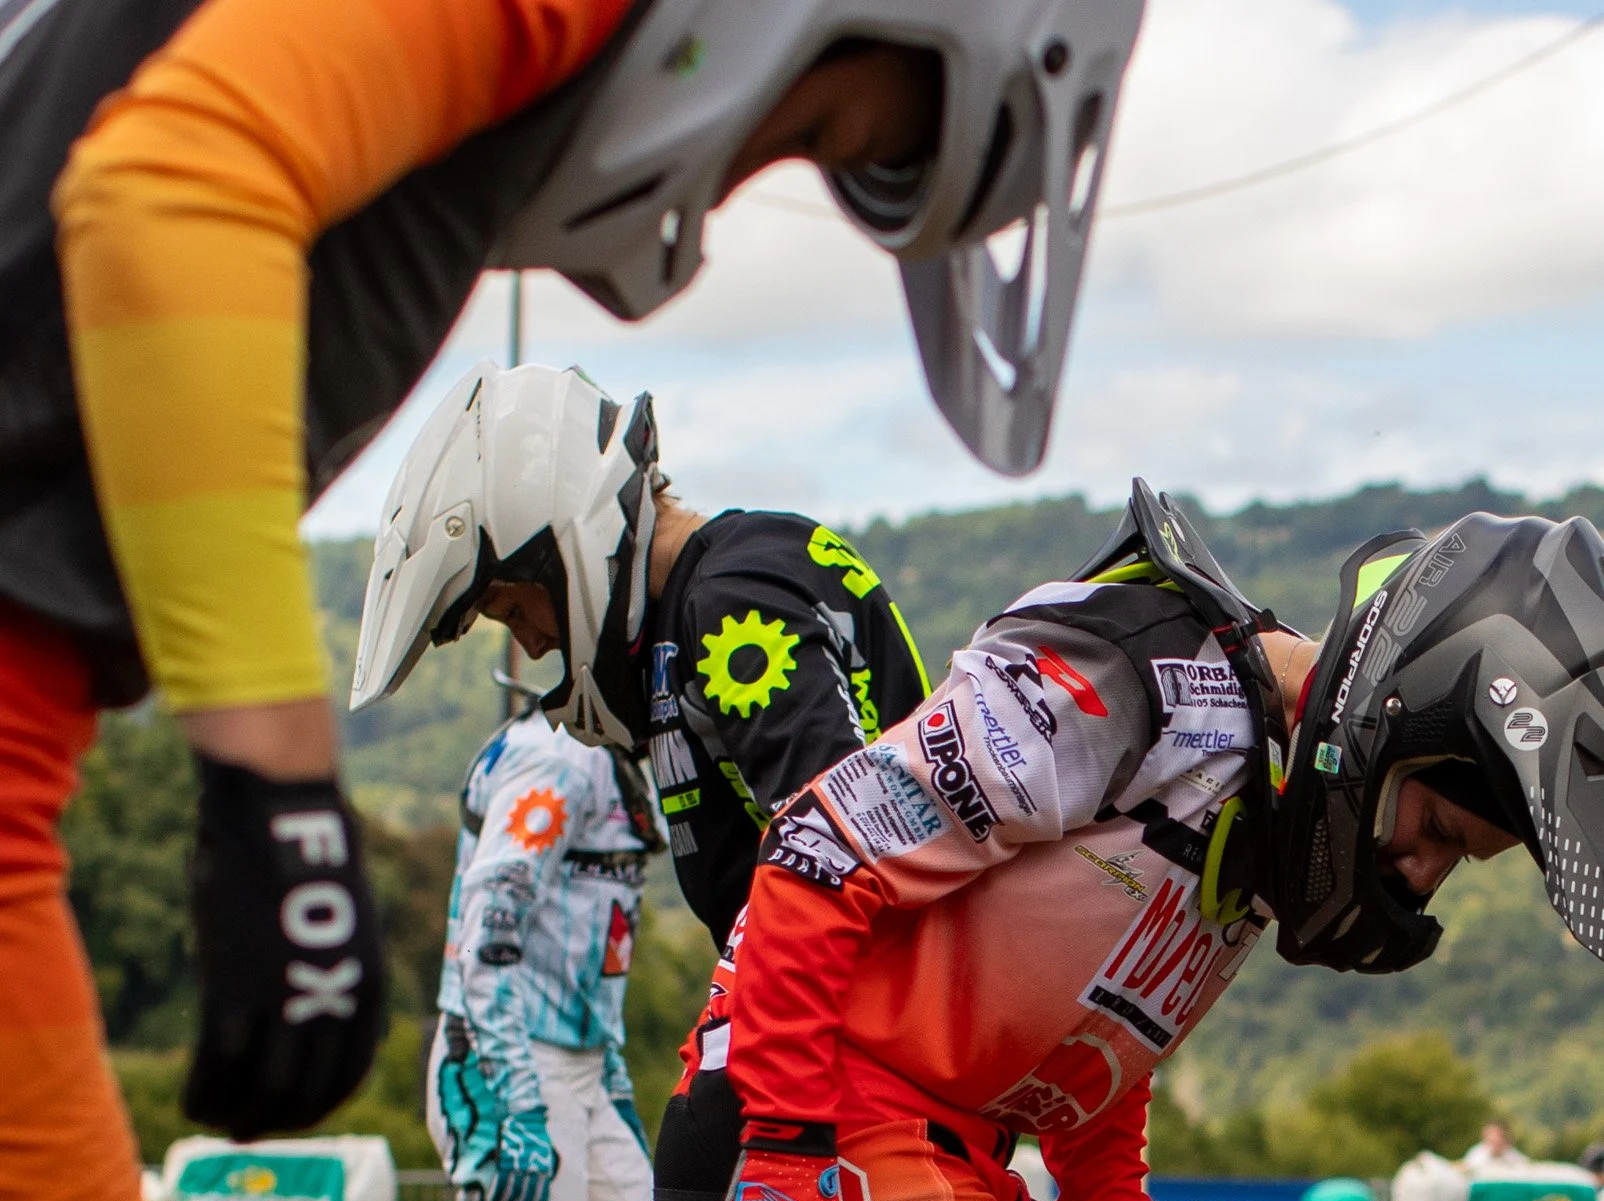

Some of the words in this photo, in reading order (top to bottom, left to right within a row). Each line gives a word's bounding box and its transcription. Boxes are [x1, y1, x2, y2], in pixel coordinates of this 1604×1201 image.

[1331, 590, 1388, 724] SCORPION
[1171, 729, 1236, 751] mettler
[766, 847, 842, 886] PARTS
[1074, 845, 1146, 893] SCORPION
[270, 812, 363, 1025] FOX
